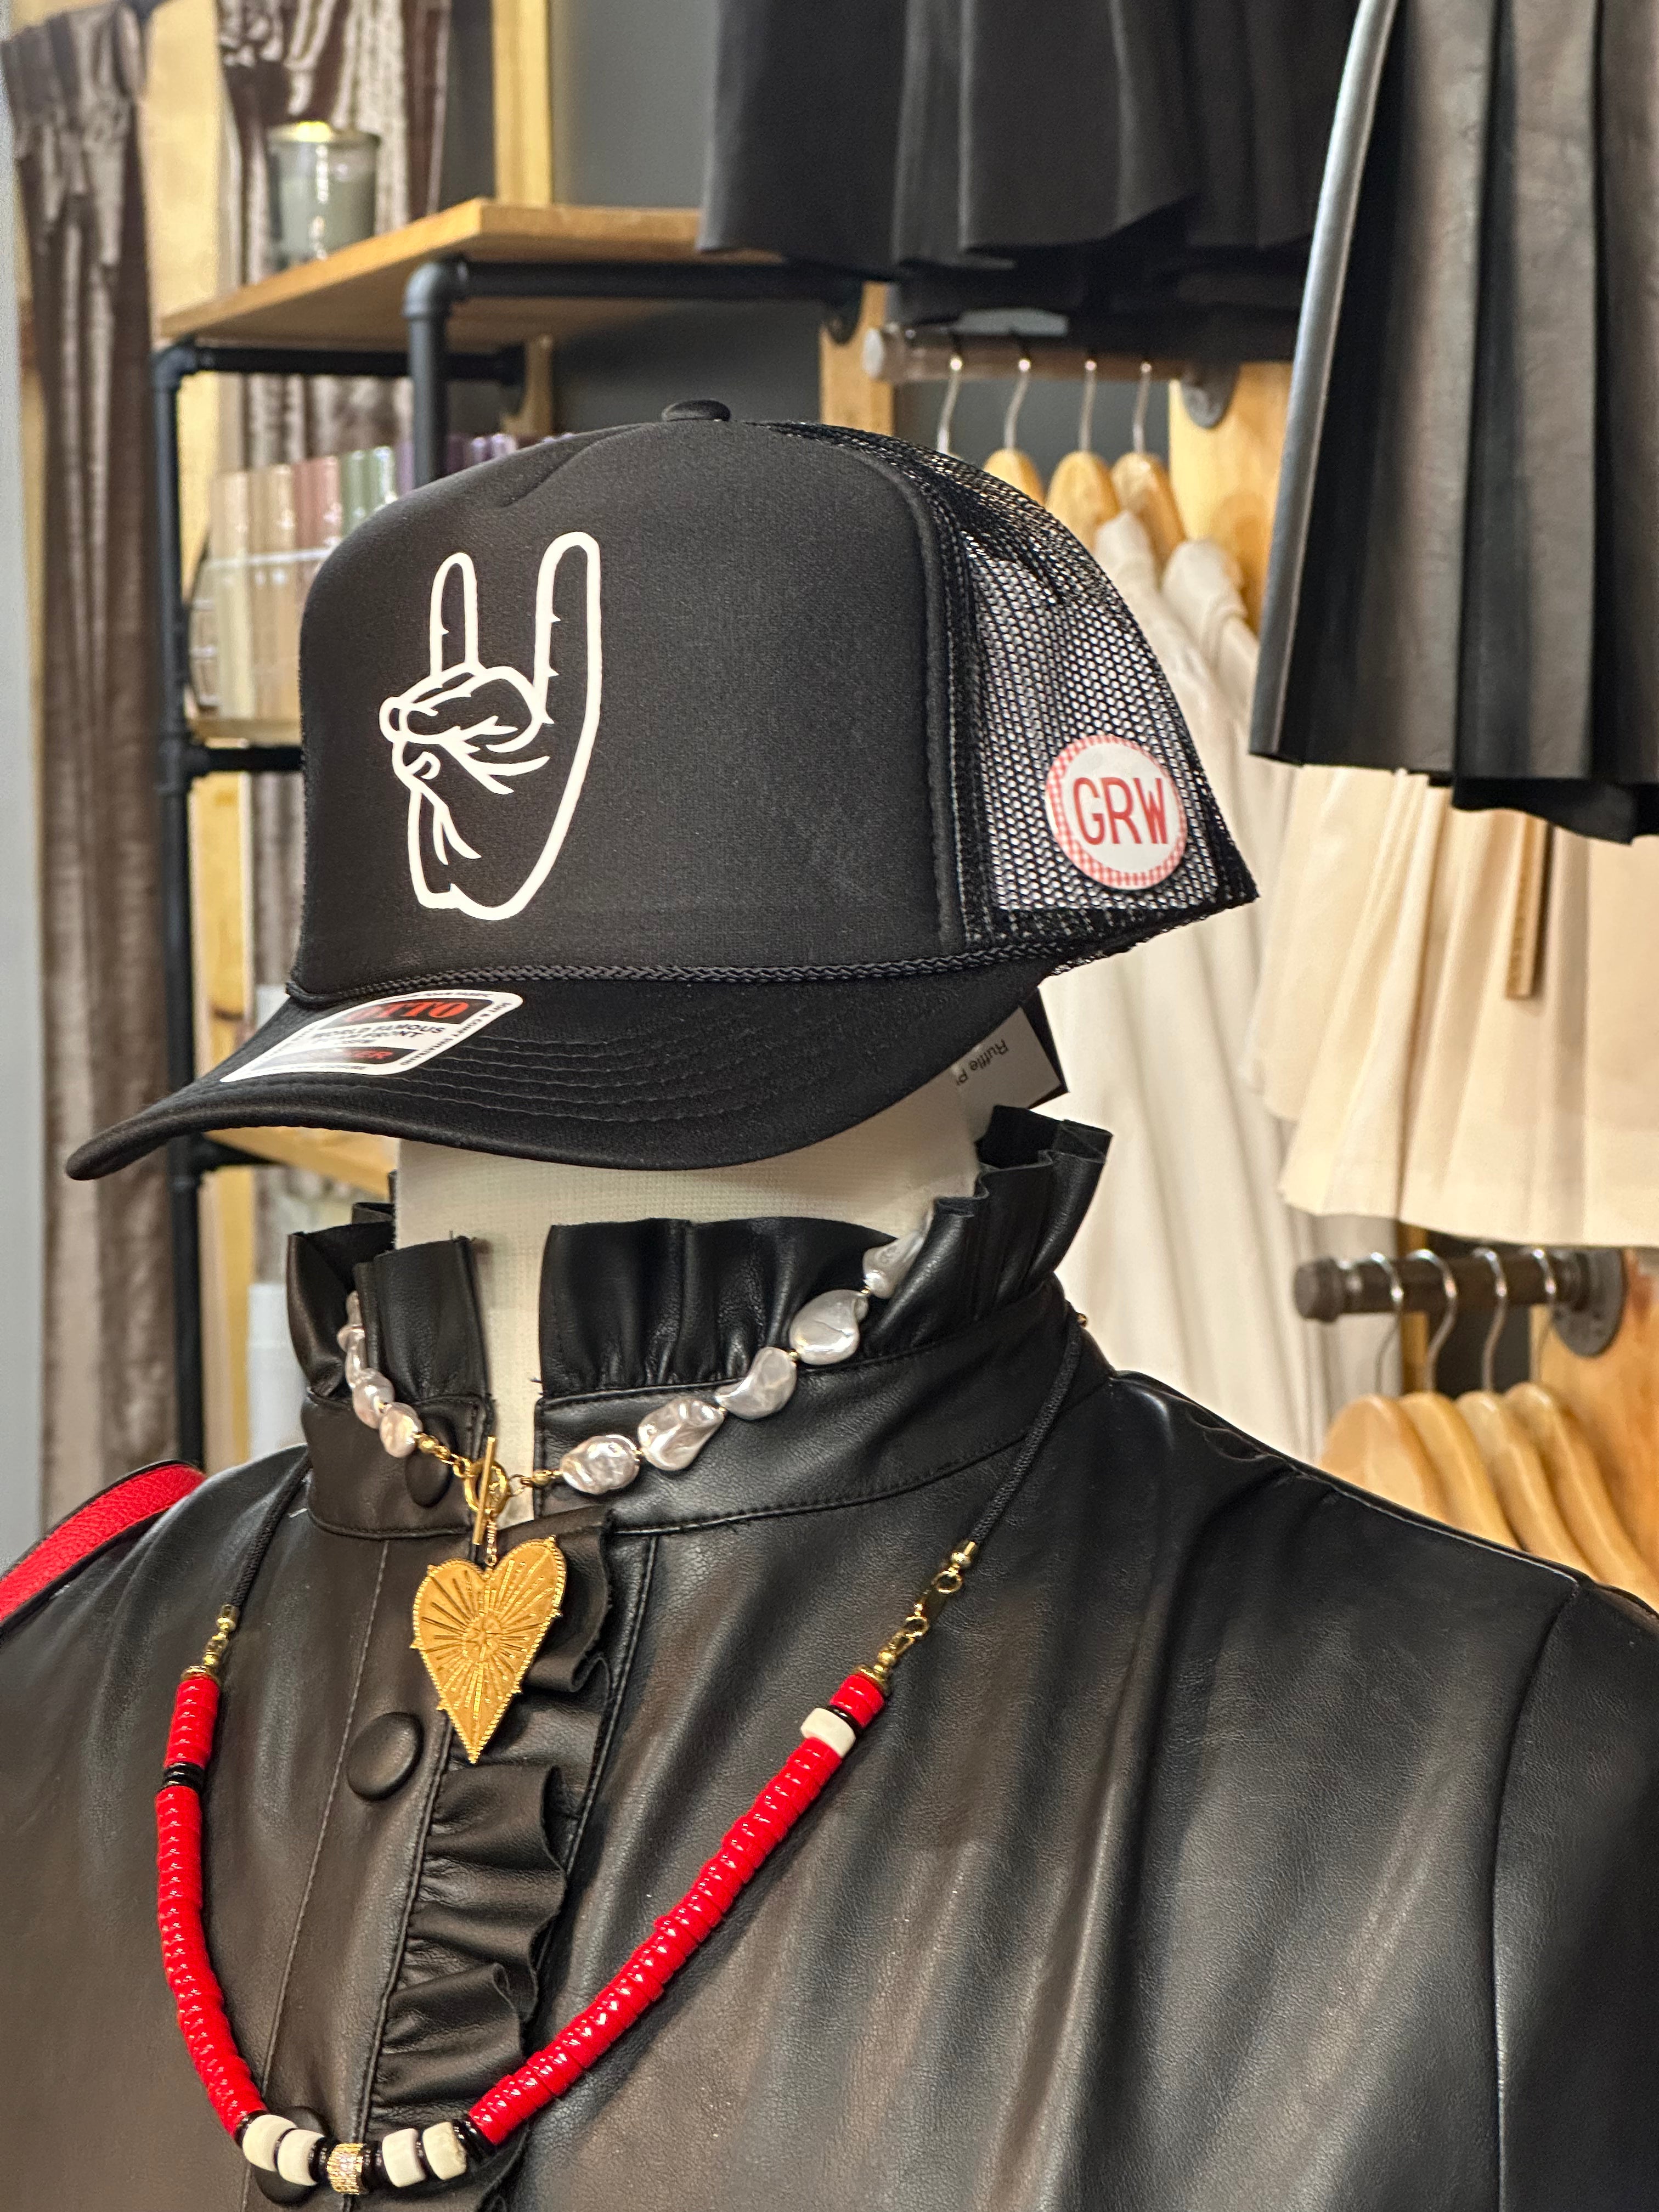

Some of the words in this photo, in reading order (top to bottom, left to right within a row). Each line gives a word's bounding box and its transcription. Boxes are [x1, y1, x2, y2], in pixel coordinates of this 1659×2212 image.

[1073, 777, 1169, 845] GRW
[343, 1001, 469, 1023] OTTO
[372, 1024, 445, 1034] FAMOUS
[968, 1039, 1009, 1070] Ruffle
